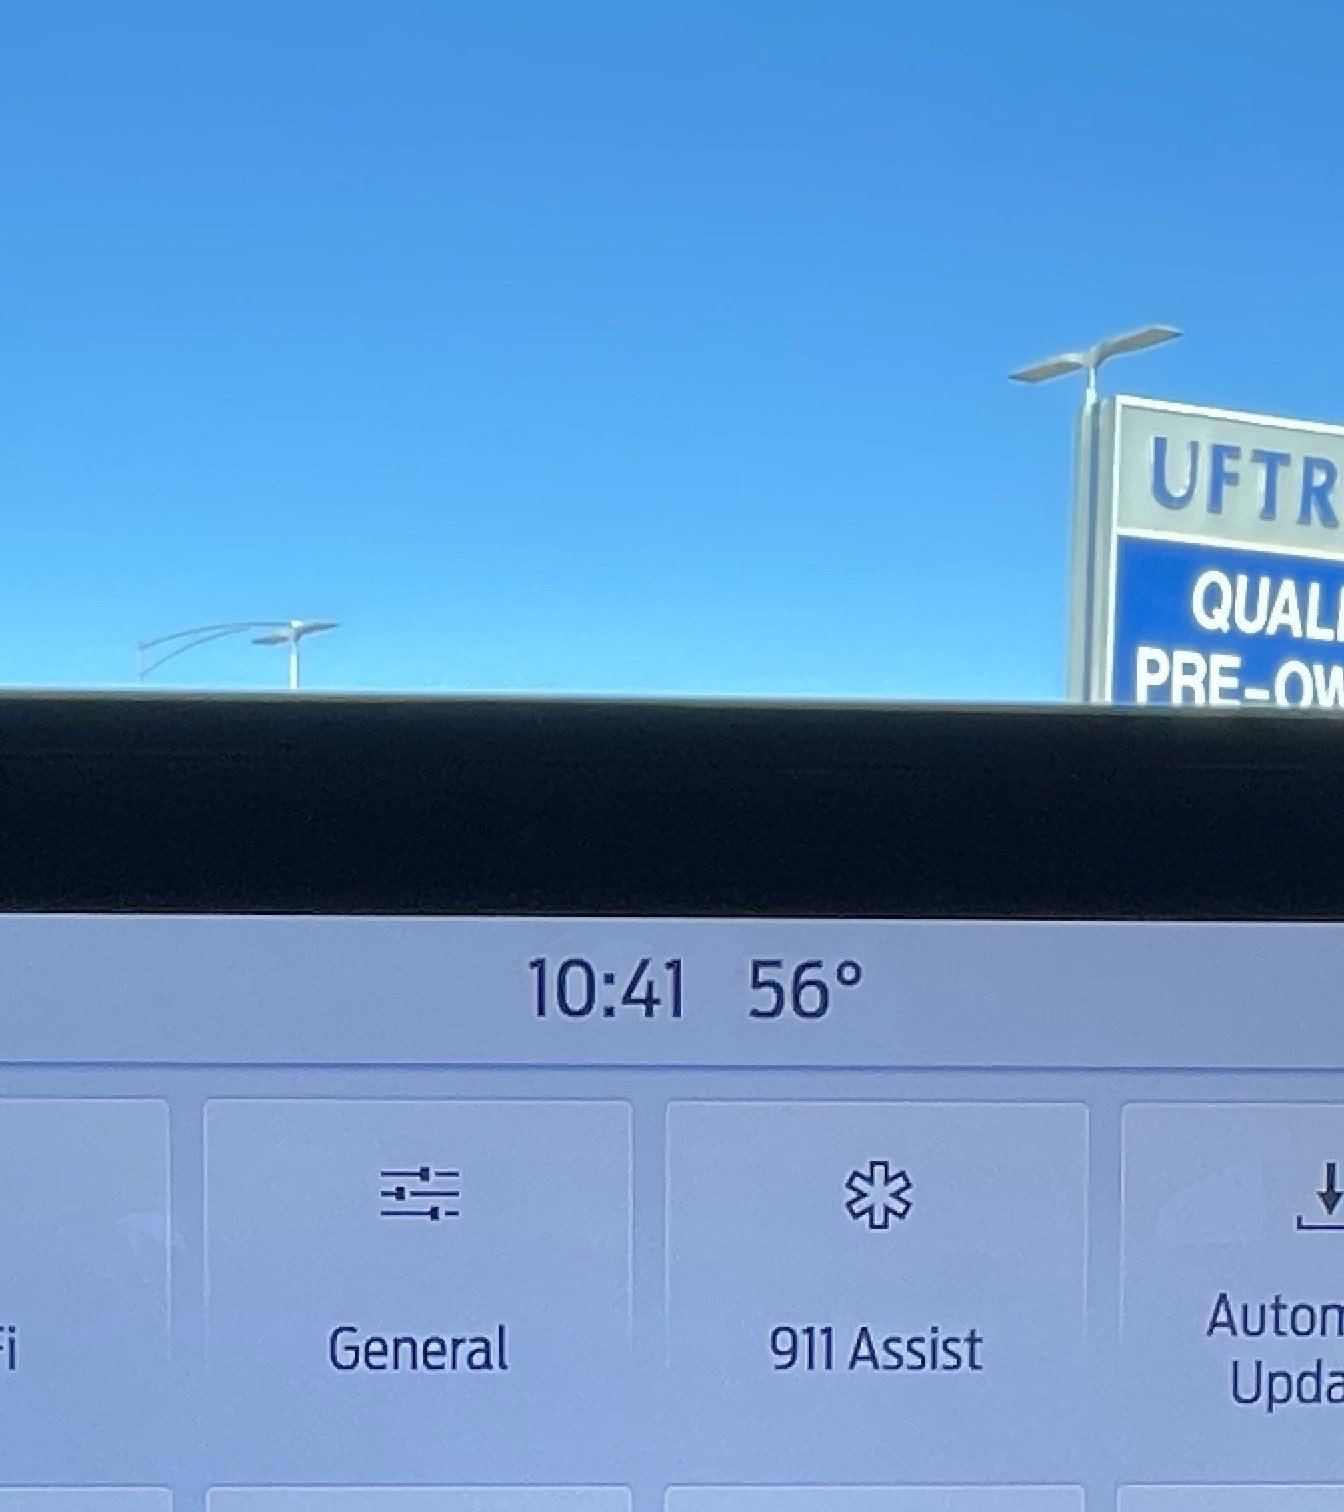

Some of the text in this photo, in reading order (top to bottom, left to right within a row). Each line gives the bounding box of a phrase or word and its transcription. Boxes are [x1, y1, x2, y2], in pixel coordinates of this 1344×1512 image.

[528, 958, 862, 1019] 10:41 56°
[330, 1324, 508, 1370] General
[770, 1326, 984, 1370] 911 Assist
